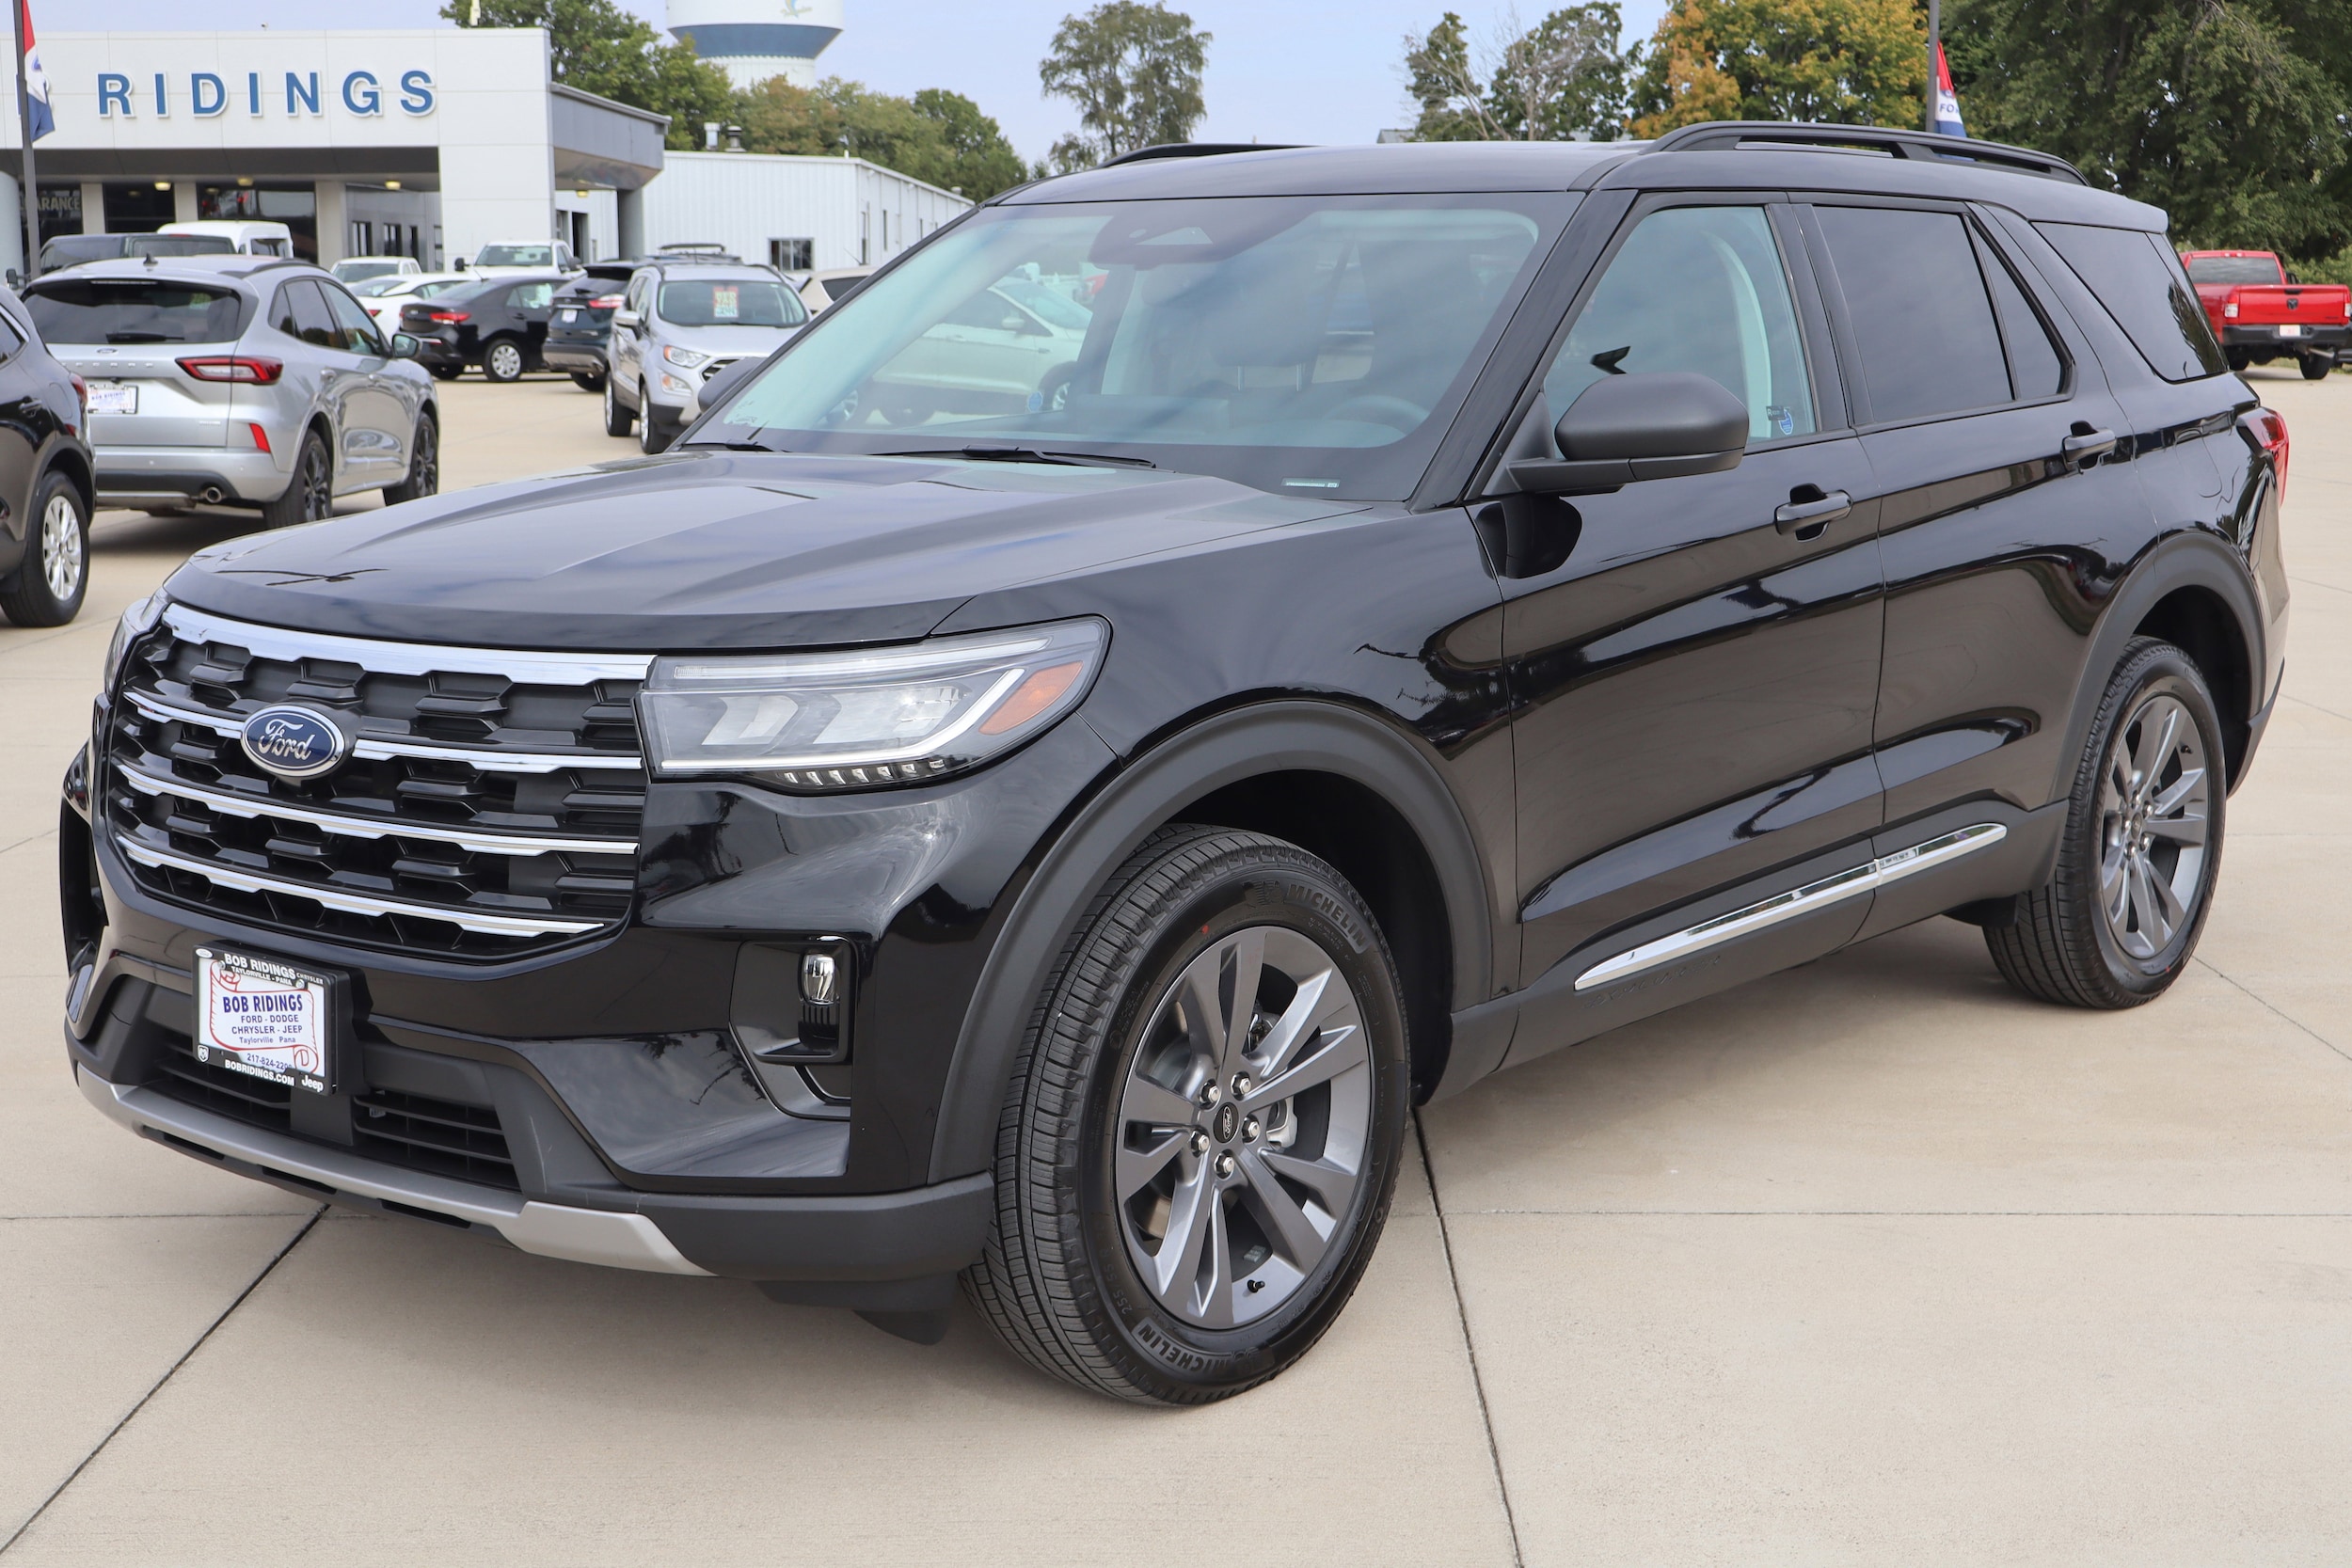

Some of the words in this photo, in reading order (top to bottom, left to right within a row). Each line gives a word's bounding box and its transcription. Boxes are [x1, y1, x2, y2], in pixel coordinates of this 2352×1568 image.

[97, 71, 436, 117] RIDINGS
[258, 719, 315, 761] Ford
[1286, 883, 1366, 948] MICHELIN
[224, 953, 248, 969] BOB
[249, 958, 297, 980] RIDINGS
[231, 966, 271, 981] TAYLORVILLE
[276, 975, 294, 987] PANA
[295, 972, 324, 985] CHRYSLER
[223, 996, 249, 1013] BOB
[253, 994, 303, 1013] RIDINGS
[241, 1015, 262, 1023] FORD
[270, 1014, 299, 1023] DODGE
[231, 1025, 275, 1035] CHRYSLER
[282, 1025, 303, 1034] JEEP
[239, 1037, 274, 1045] Taylorville
[225, 1059, 295, 1086] BOBRIDINGS.COM
[301, 1075, 324, 1092] Jeep
[1138, 1323, 1229, 1372] MICHELIN
